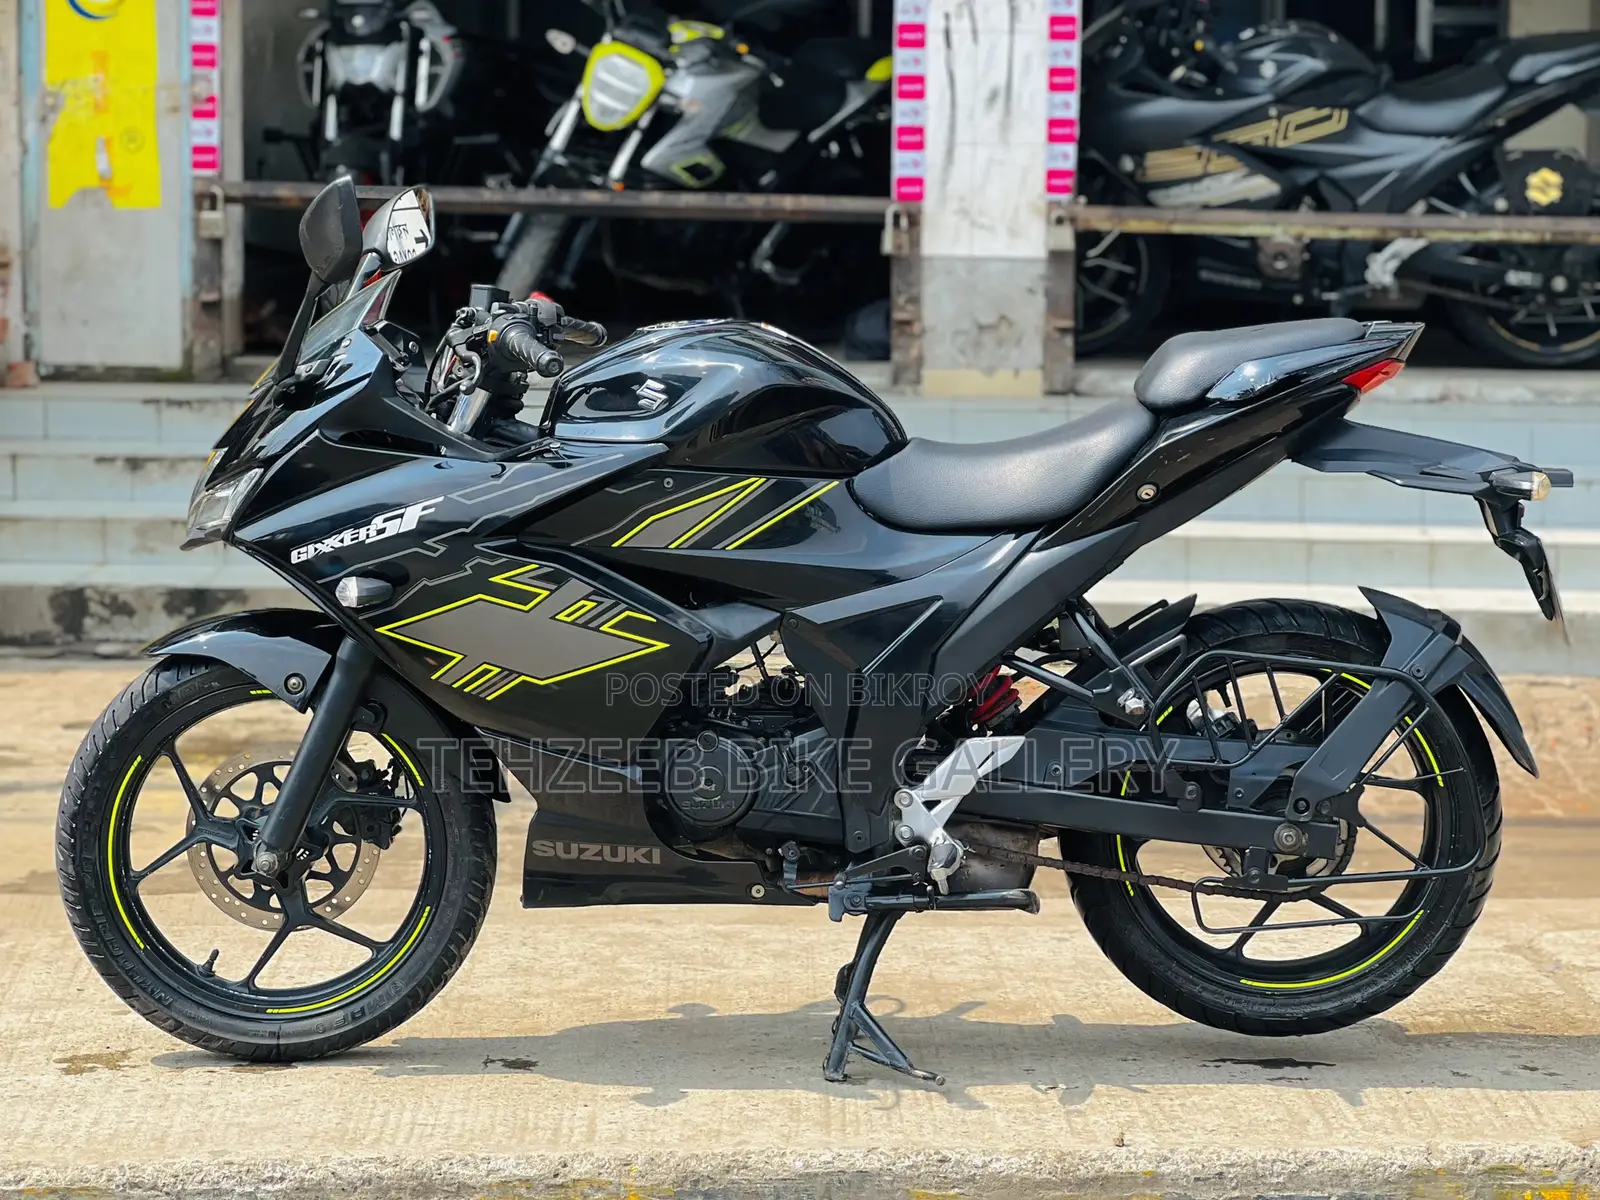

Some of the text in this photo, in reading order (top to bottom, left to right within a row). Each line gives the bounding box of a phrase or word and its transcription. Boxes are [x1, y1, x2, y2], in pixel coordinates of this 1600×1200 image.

[290, 495, 445, 565] GIXXER SF
[532, 839, 661, 865] SUZUKI
